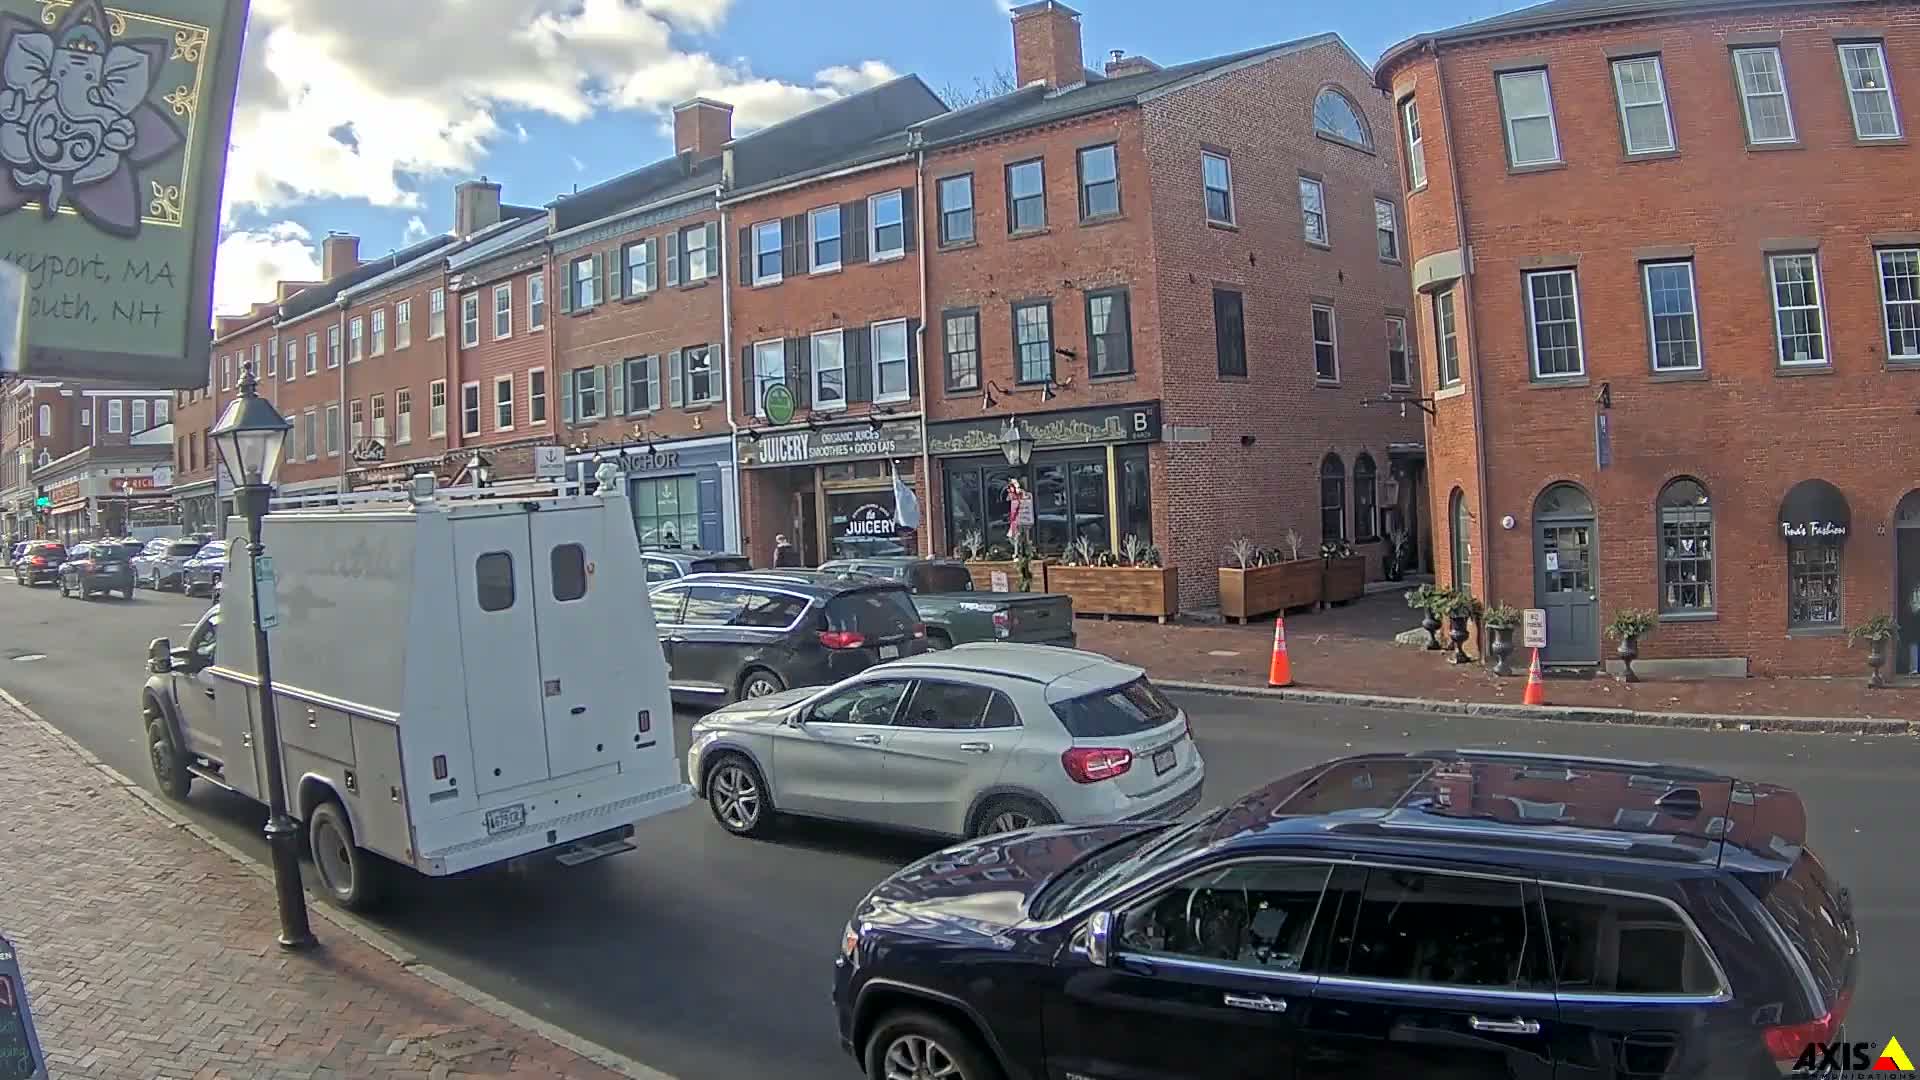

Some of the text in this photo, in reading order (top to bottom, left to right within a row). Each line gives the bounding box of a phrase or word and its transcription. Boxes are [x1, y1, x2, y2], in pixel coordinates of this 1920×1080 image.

[122, 259, 175, 288] MA
[112, 300, 162, 328] NH
[1134, 412, 1147, 431] B
[821, 429, 880, 444] ORGANIC JUICES
[758, 433, 809, 463] JUICERY
[808, 440, 896, 458] SMOOTHIES GOOD EATS
[846, 519, 896, 535] JUICERY
[1782, 522, 1807, 536] Tina's
